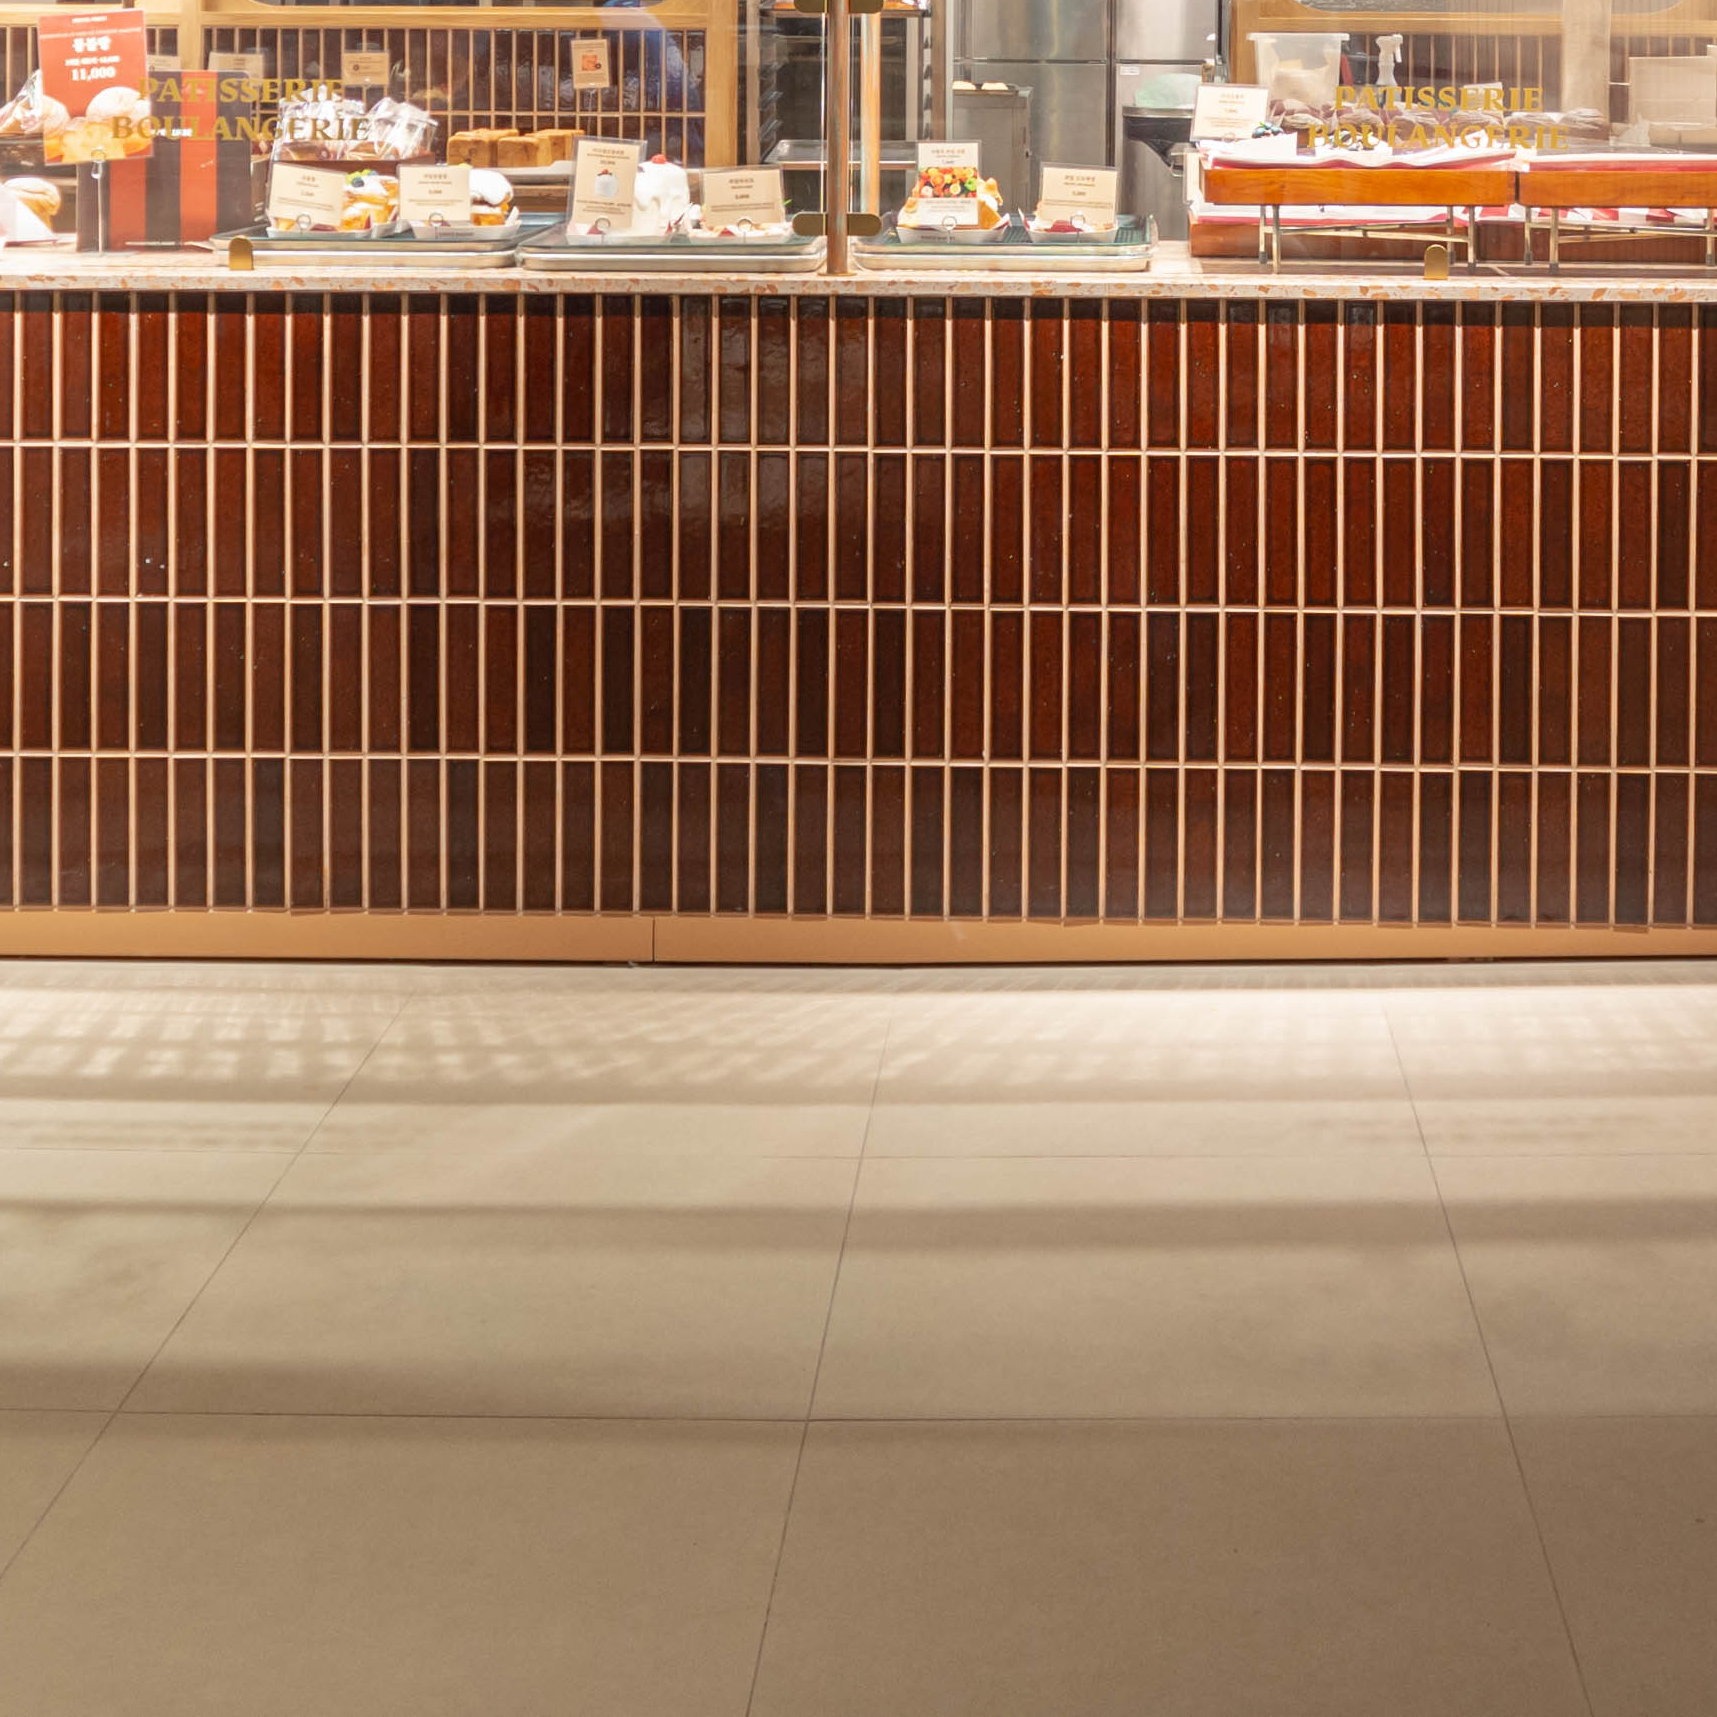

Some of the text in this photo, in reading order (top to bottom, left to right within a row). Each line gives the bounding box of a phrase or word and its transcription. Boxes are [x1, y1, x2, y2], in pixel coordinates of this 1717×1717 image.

[71, 66, 116, 81] 11,000
[138, 77, 346, 103] PATISSERIE
[1334, 85, 1545, 113] PATISSERIE
[111, 115, 371, 141] BOULANGERIE
[1306, 121, 1570, 150] BOULANGERIE
